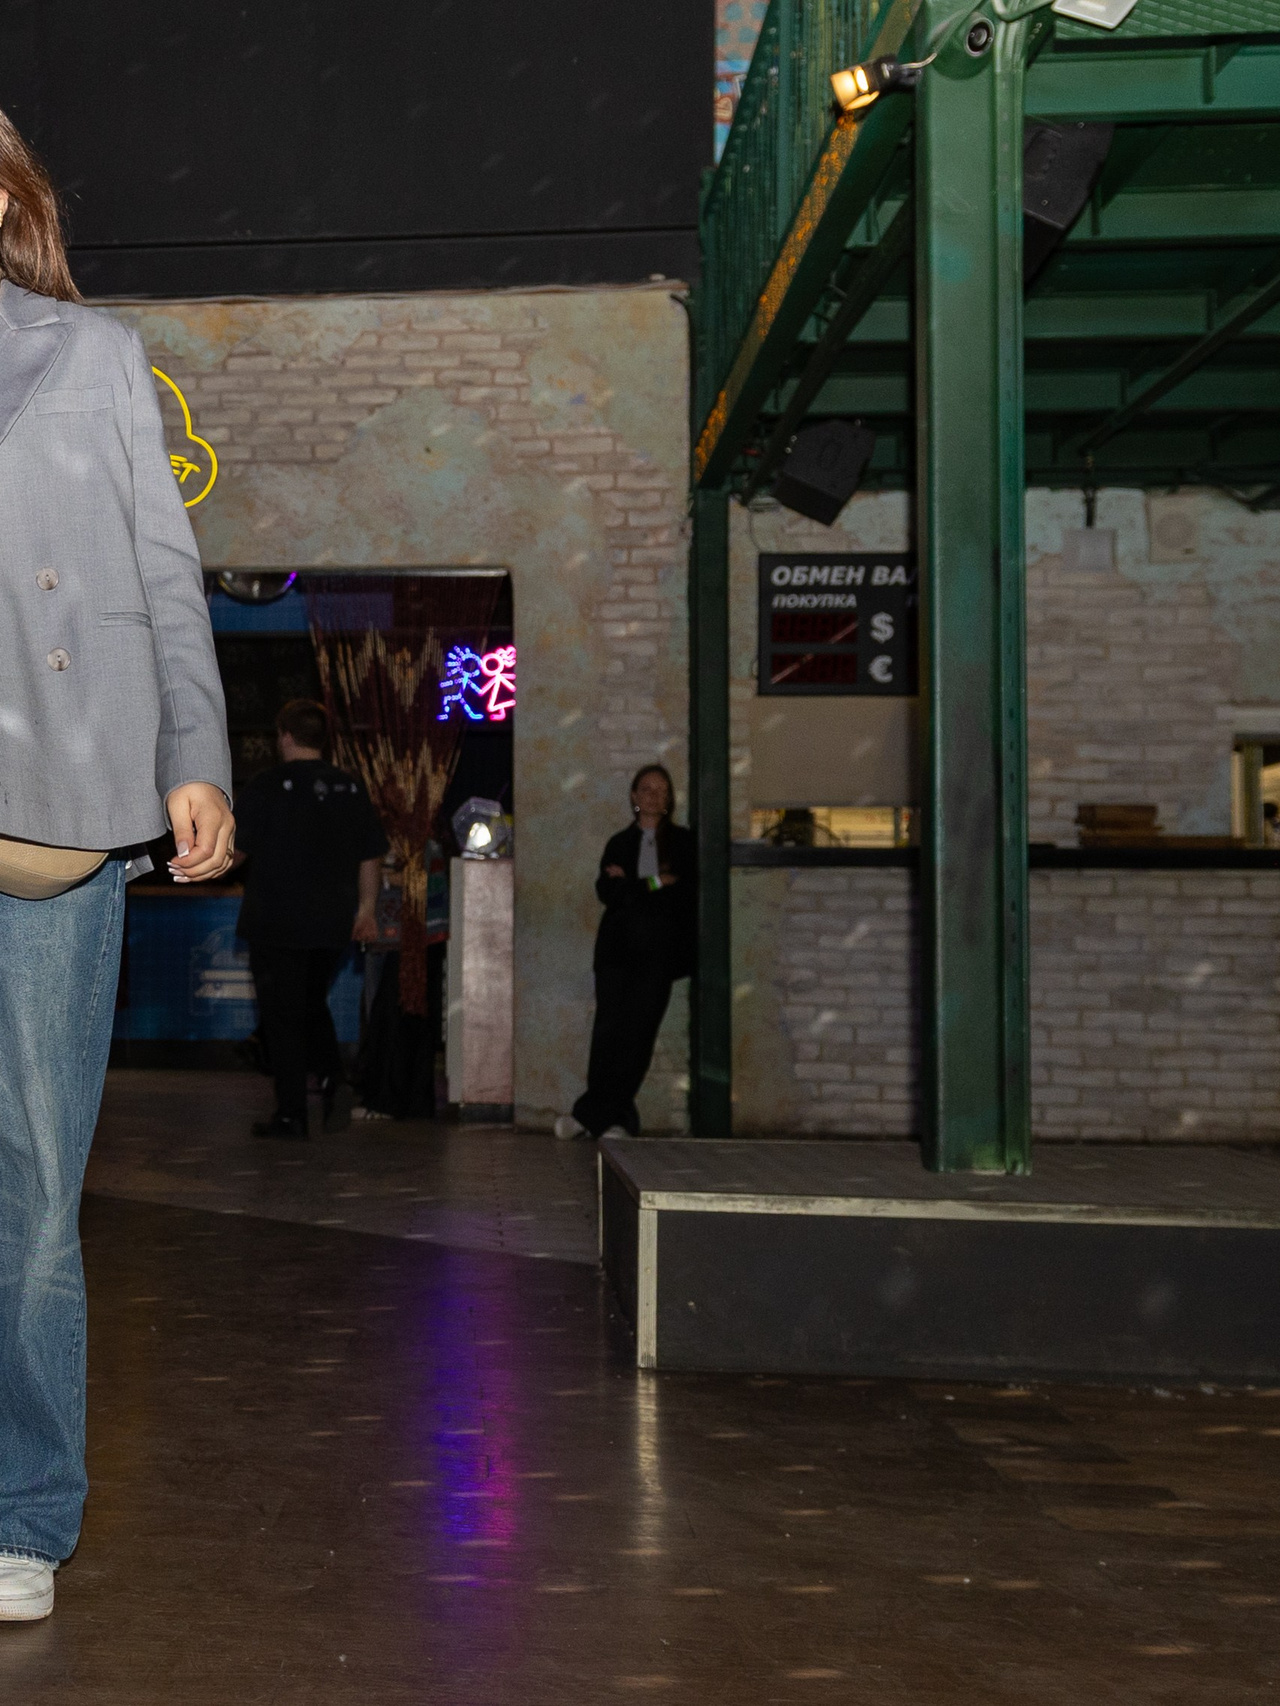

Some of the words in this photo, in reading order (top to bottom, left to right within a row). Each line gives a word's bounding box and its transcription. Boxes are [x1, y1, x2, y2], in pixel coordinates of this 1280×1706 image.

[771, 565, 866, 587] ОБМЕН
[772, 593, 857, 608] ПОКУПКА
[871, 611, 895, 644] $
[869, 655, 893, 684] €
